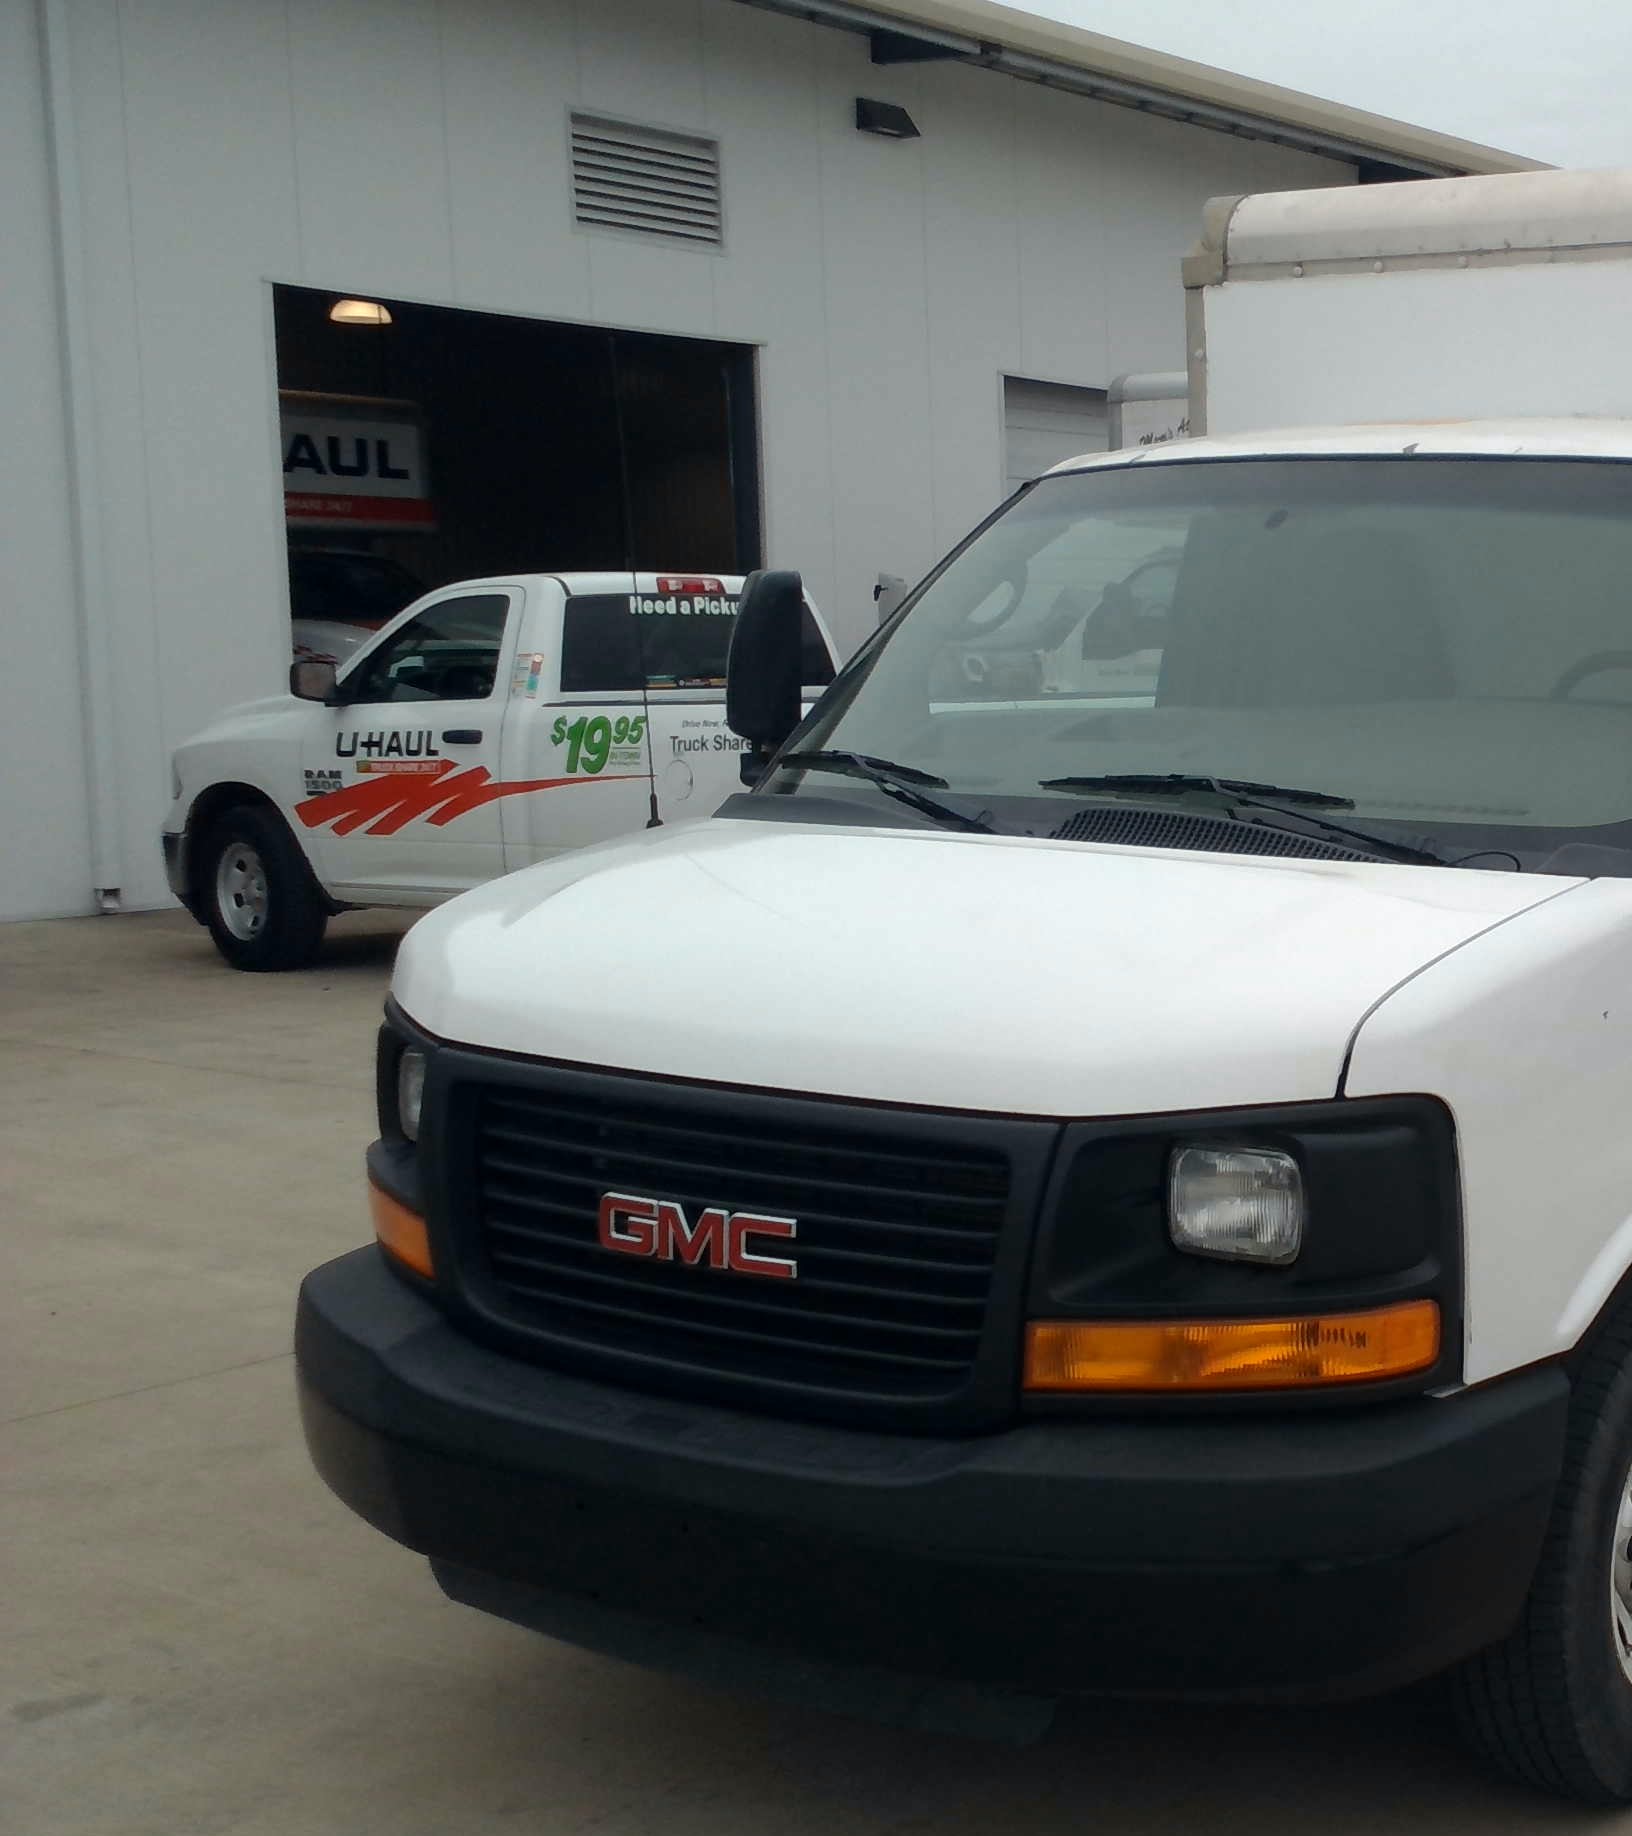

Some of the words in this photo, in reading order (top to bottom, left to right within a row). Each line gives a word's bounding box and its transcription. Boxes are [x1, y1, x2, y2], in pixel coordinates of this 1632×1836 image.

[628, 596, 677, 615] Need
[679, 600, 691, 615] a
[335, 730, 440, 758] U-HAUL
[670, 736, 710, 753] Truck
[304, 769, 343, 779] RAM
[304, 780, 344, 791] 1500
[600, 1191, 798, 1280] GMC
